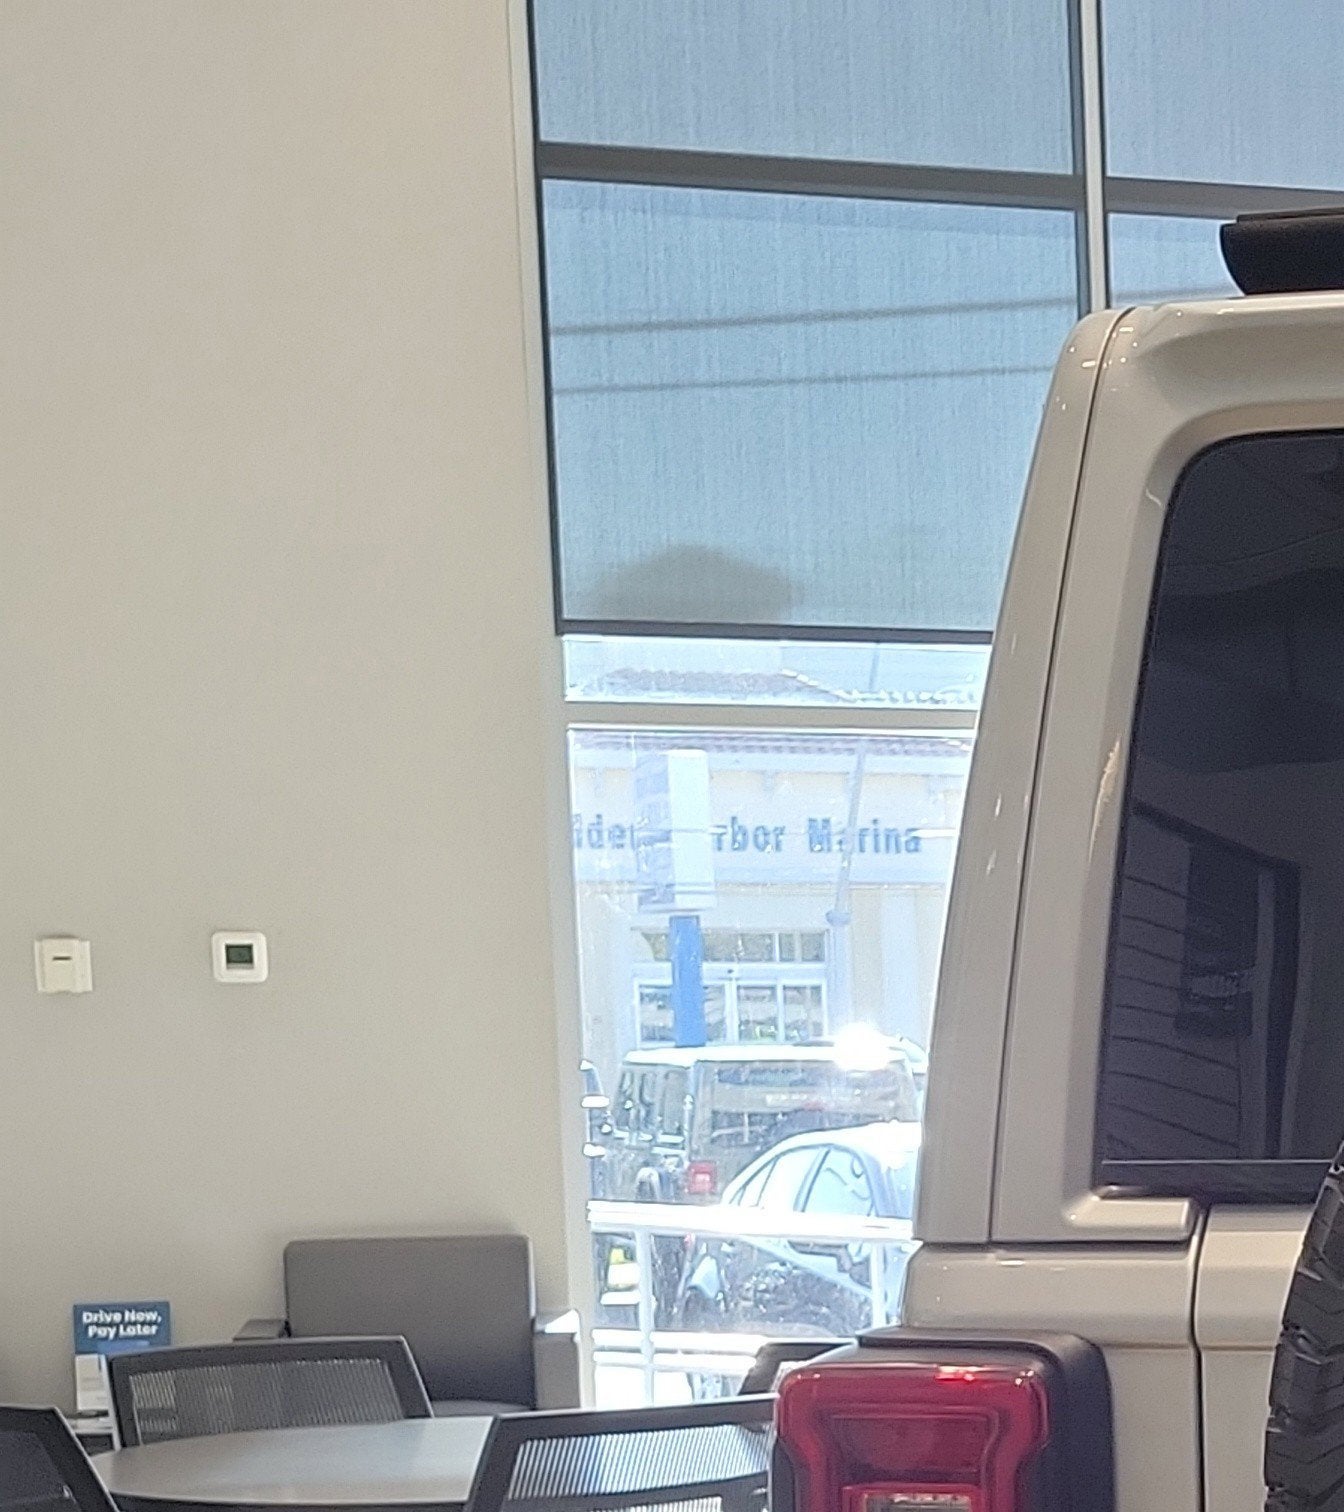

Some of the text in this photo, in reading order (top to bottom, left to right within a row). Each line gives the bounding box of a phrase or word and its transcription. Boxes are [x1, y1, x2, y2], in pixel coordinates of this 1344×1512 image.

[710, 816, 785, 852] rbor
[82, 1308, 162, 1325] Drive Now,
[88, 1323, 158, 1341] Pay Later
